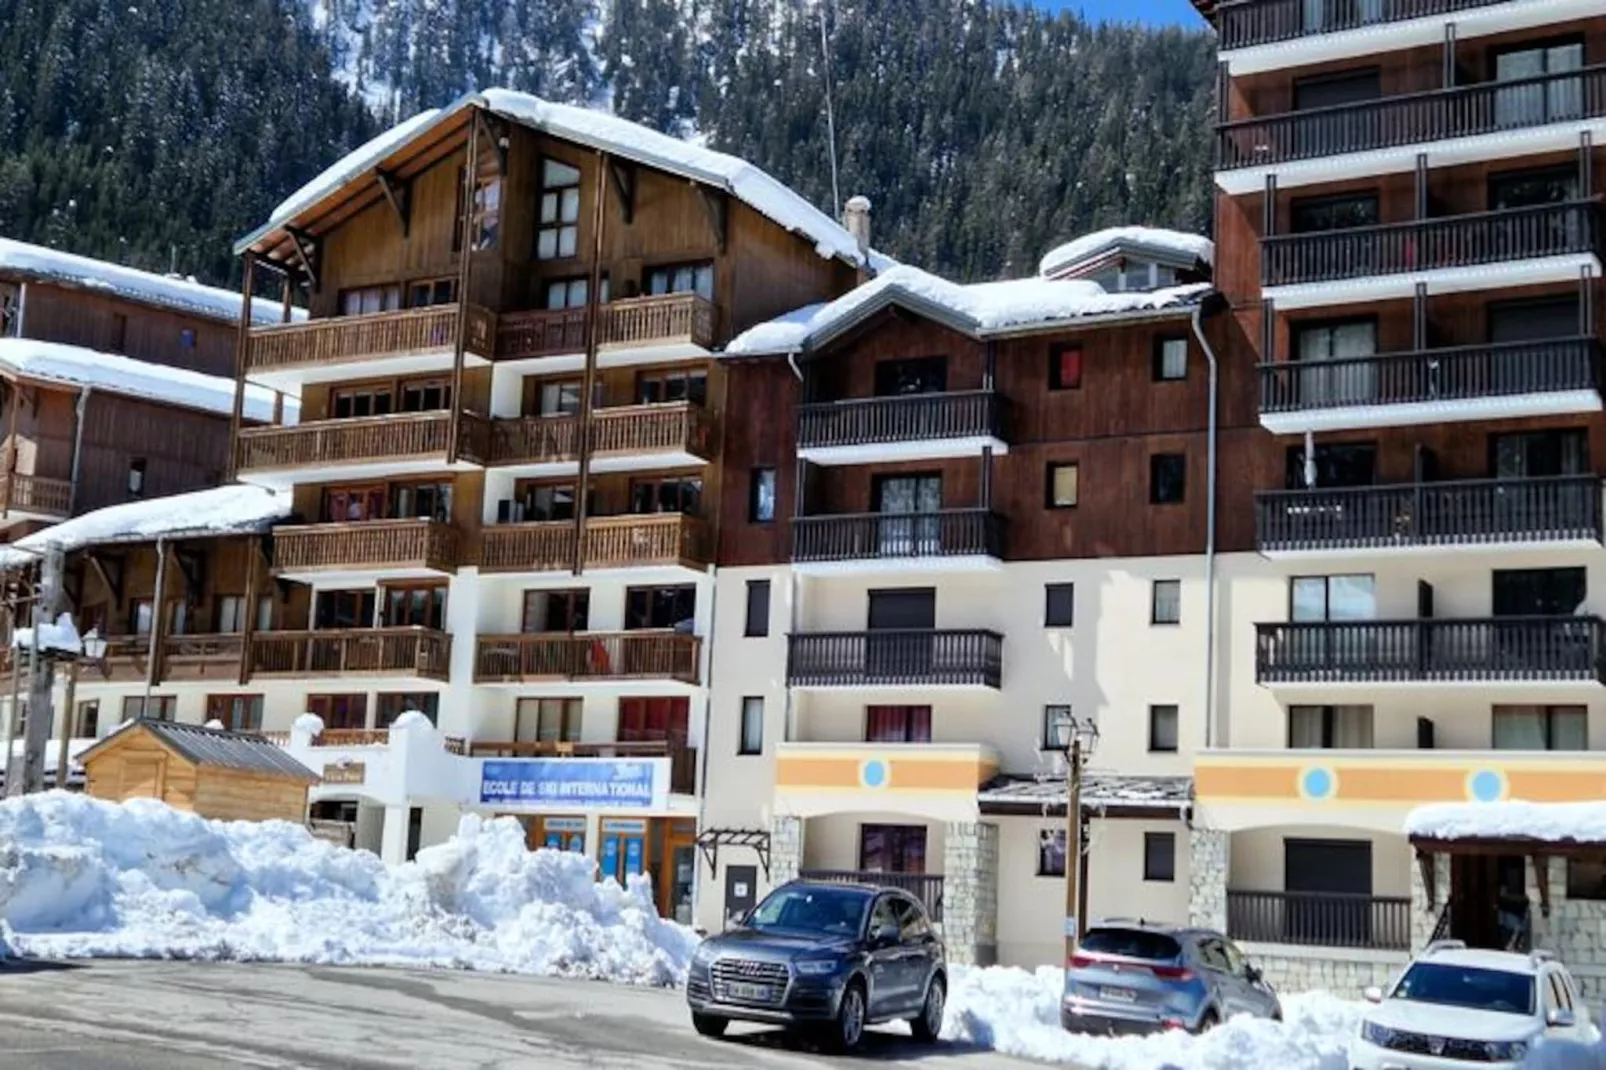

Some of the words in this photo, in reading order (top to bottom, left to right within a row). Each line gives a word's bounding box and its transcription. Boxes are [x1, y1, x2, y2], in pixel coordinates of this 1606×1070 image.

[482, 780, 517, 795] ECOLE
[520, 781, 535, 795] DE
[538, 781, 557, 795] SKI
[559, 781, 650, 797] INTERNATIONAL
